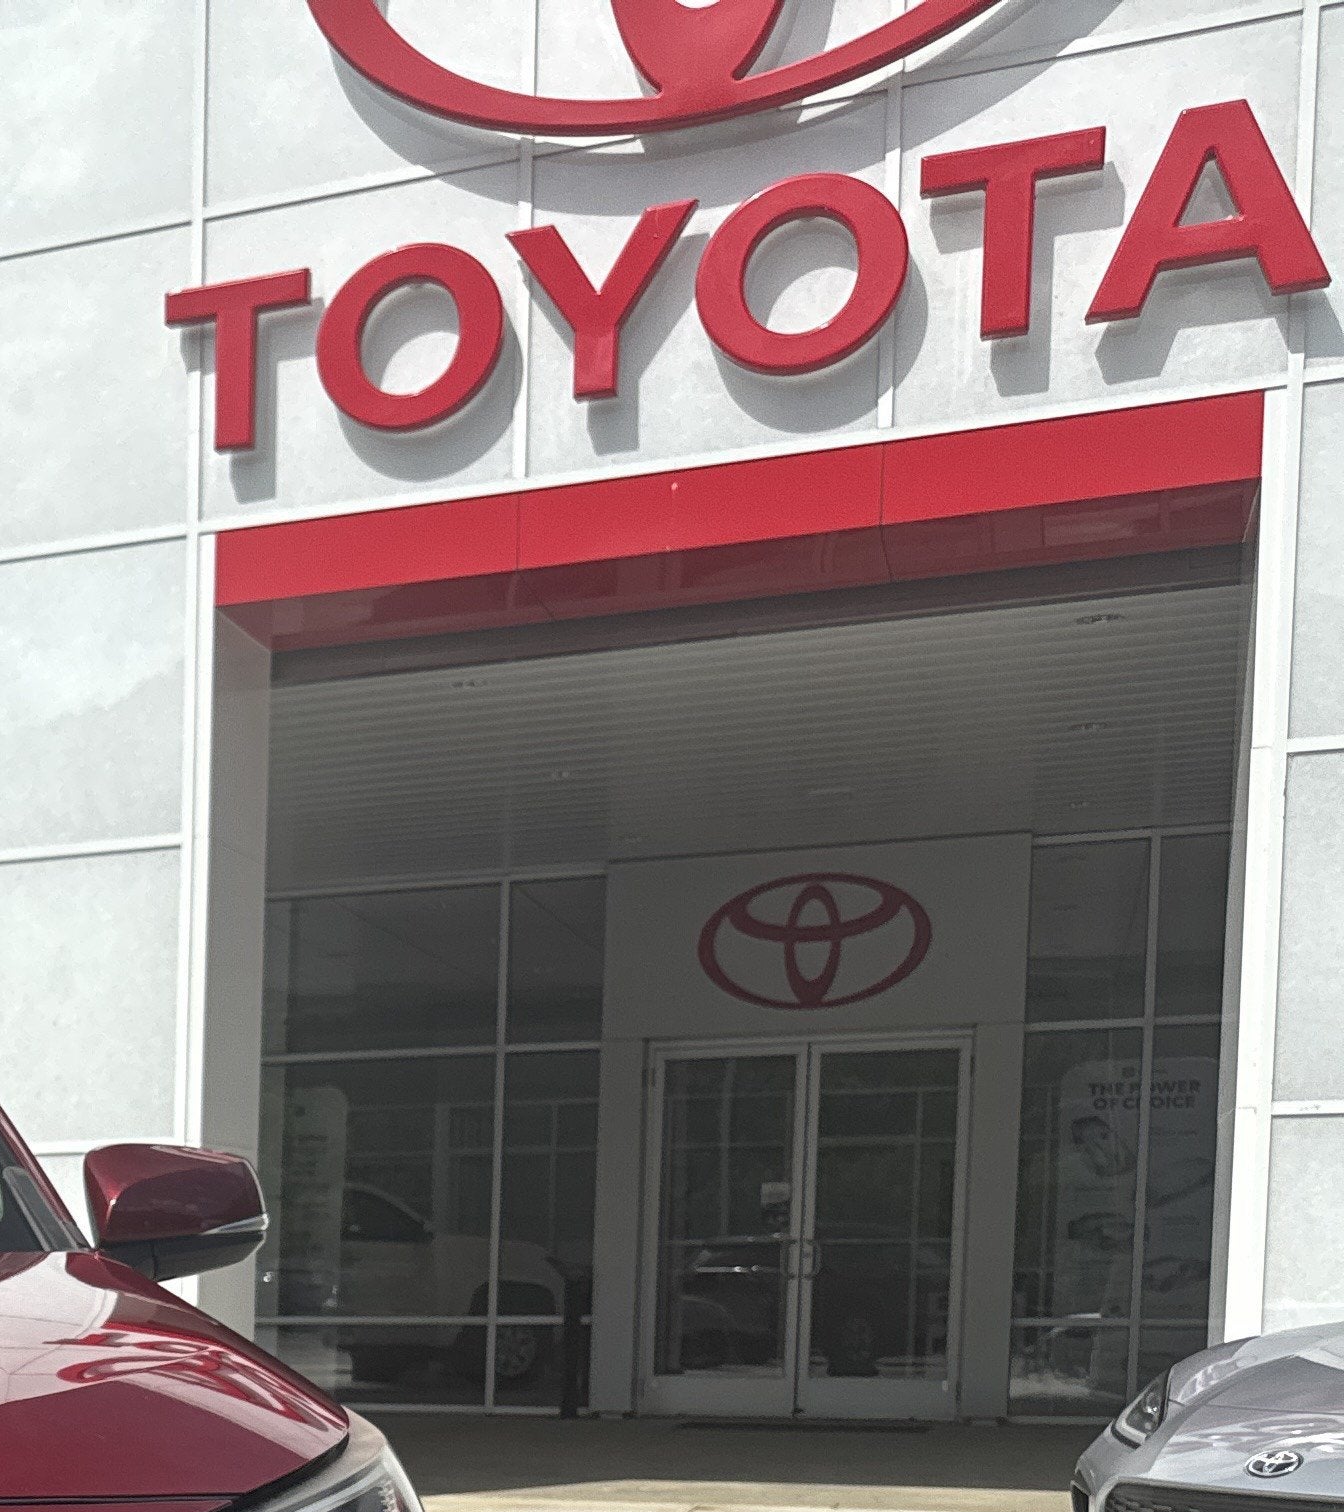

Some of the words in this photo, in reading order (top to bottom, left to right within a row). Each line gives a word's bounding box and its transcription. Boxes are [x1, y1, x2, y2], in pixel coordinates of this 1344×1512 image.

[165, 99, 1331, 452] TOYOTA
[1088, 1082, 1123, 1095] THE
[1093, 1096, 1119, 1110] OF
